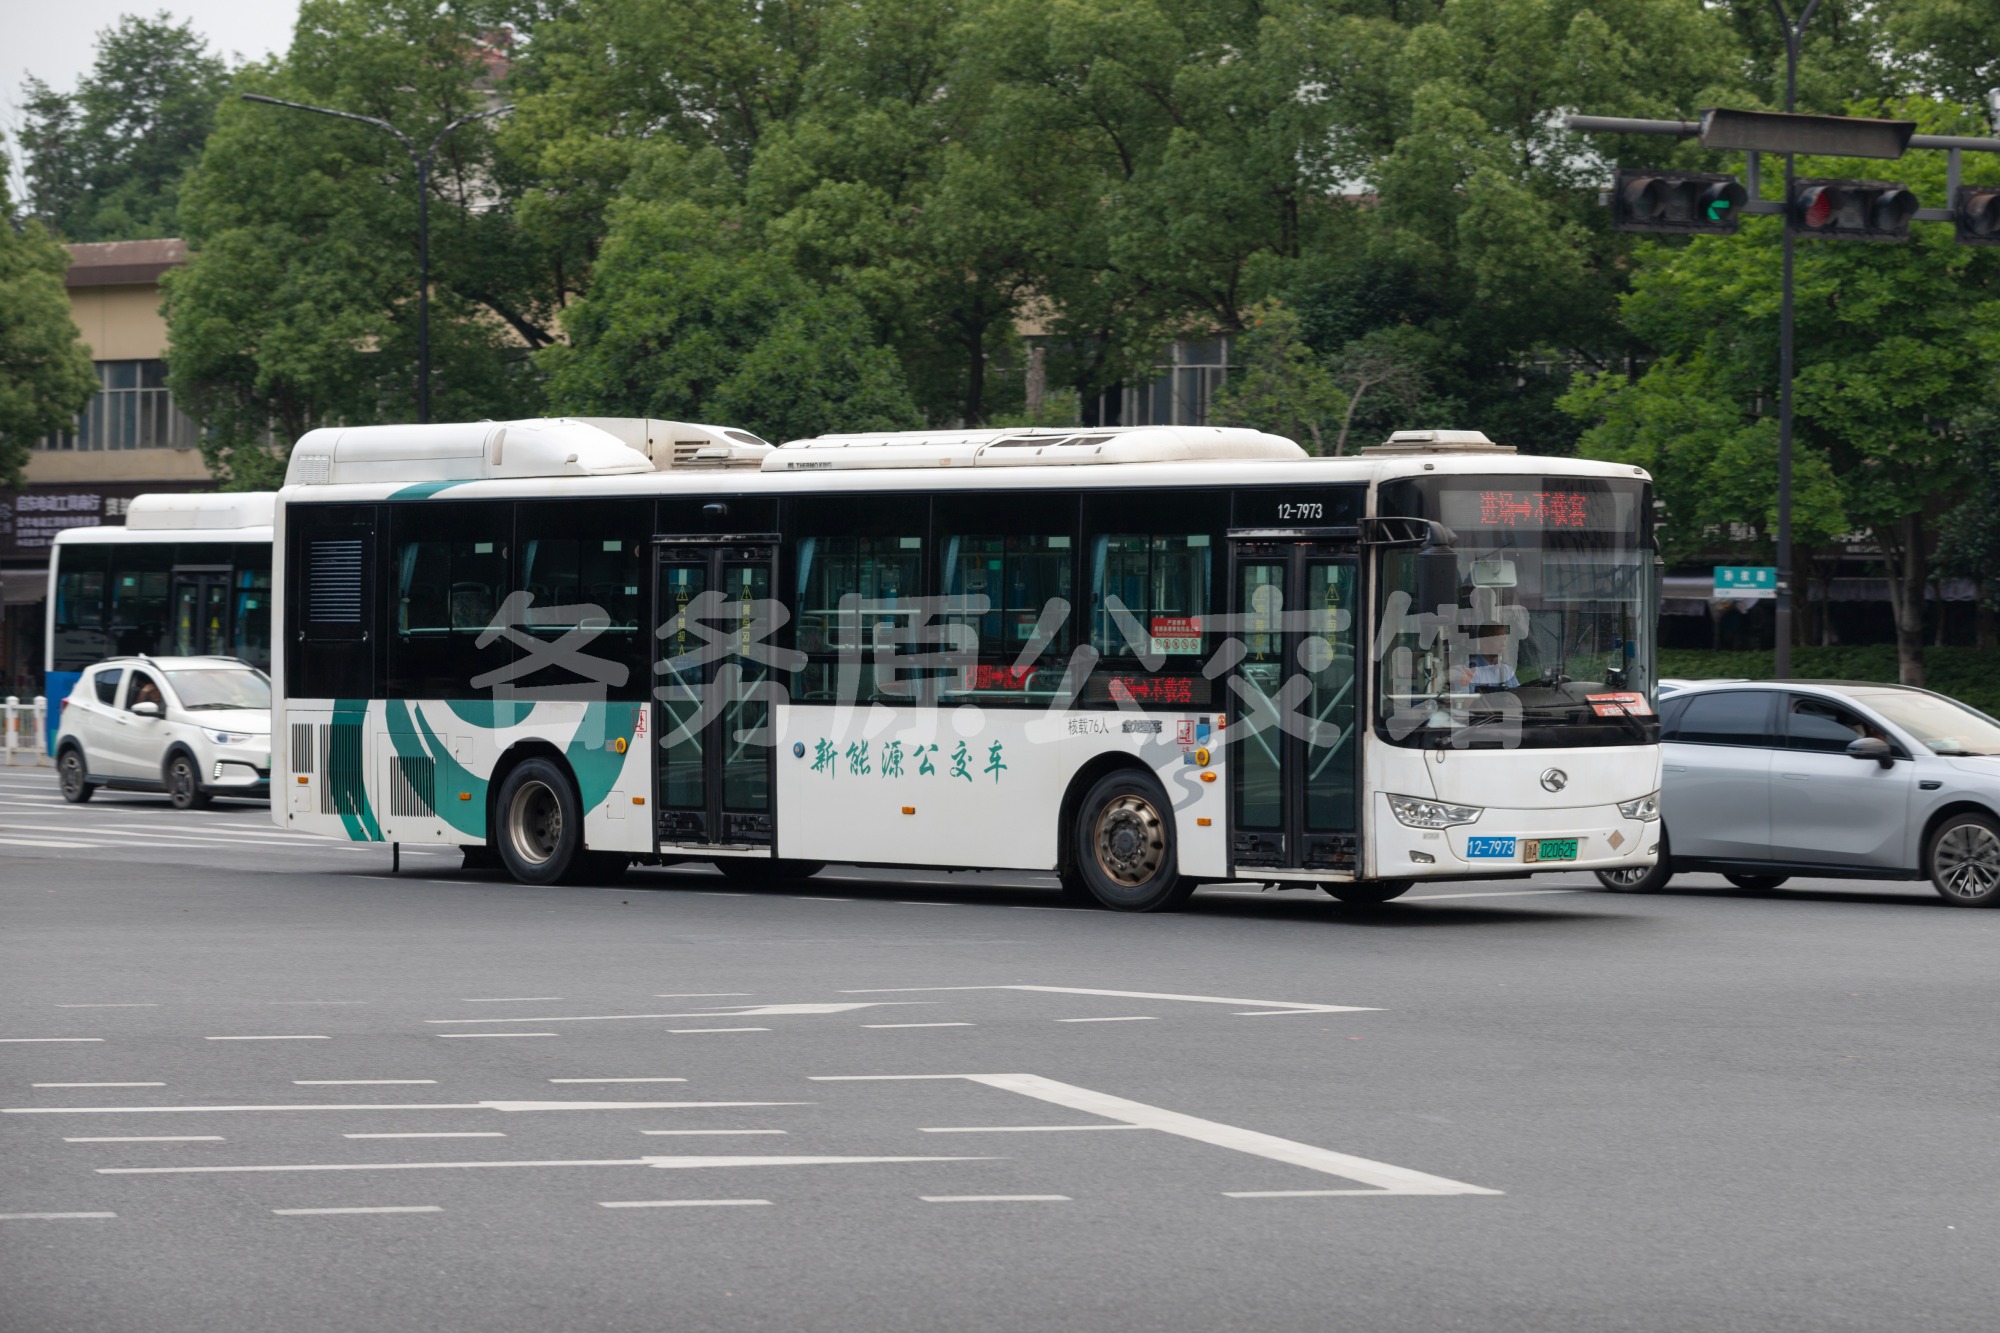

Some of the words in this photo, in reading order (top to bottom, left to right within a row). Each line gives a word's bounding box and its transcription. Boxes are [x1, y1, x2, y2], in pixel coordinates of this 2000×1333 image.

[1277, 503, 1323, 519] 12-7973
[1067, 717, 1109, 735] 核载76人
[810, 737, 1008, 785] 新能源公交车
[1467, 840, 1515, 855] 12-7973
